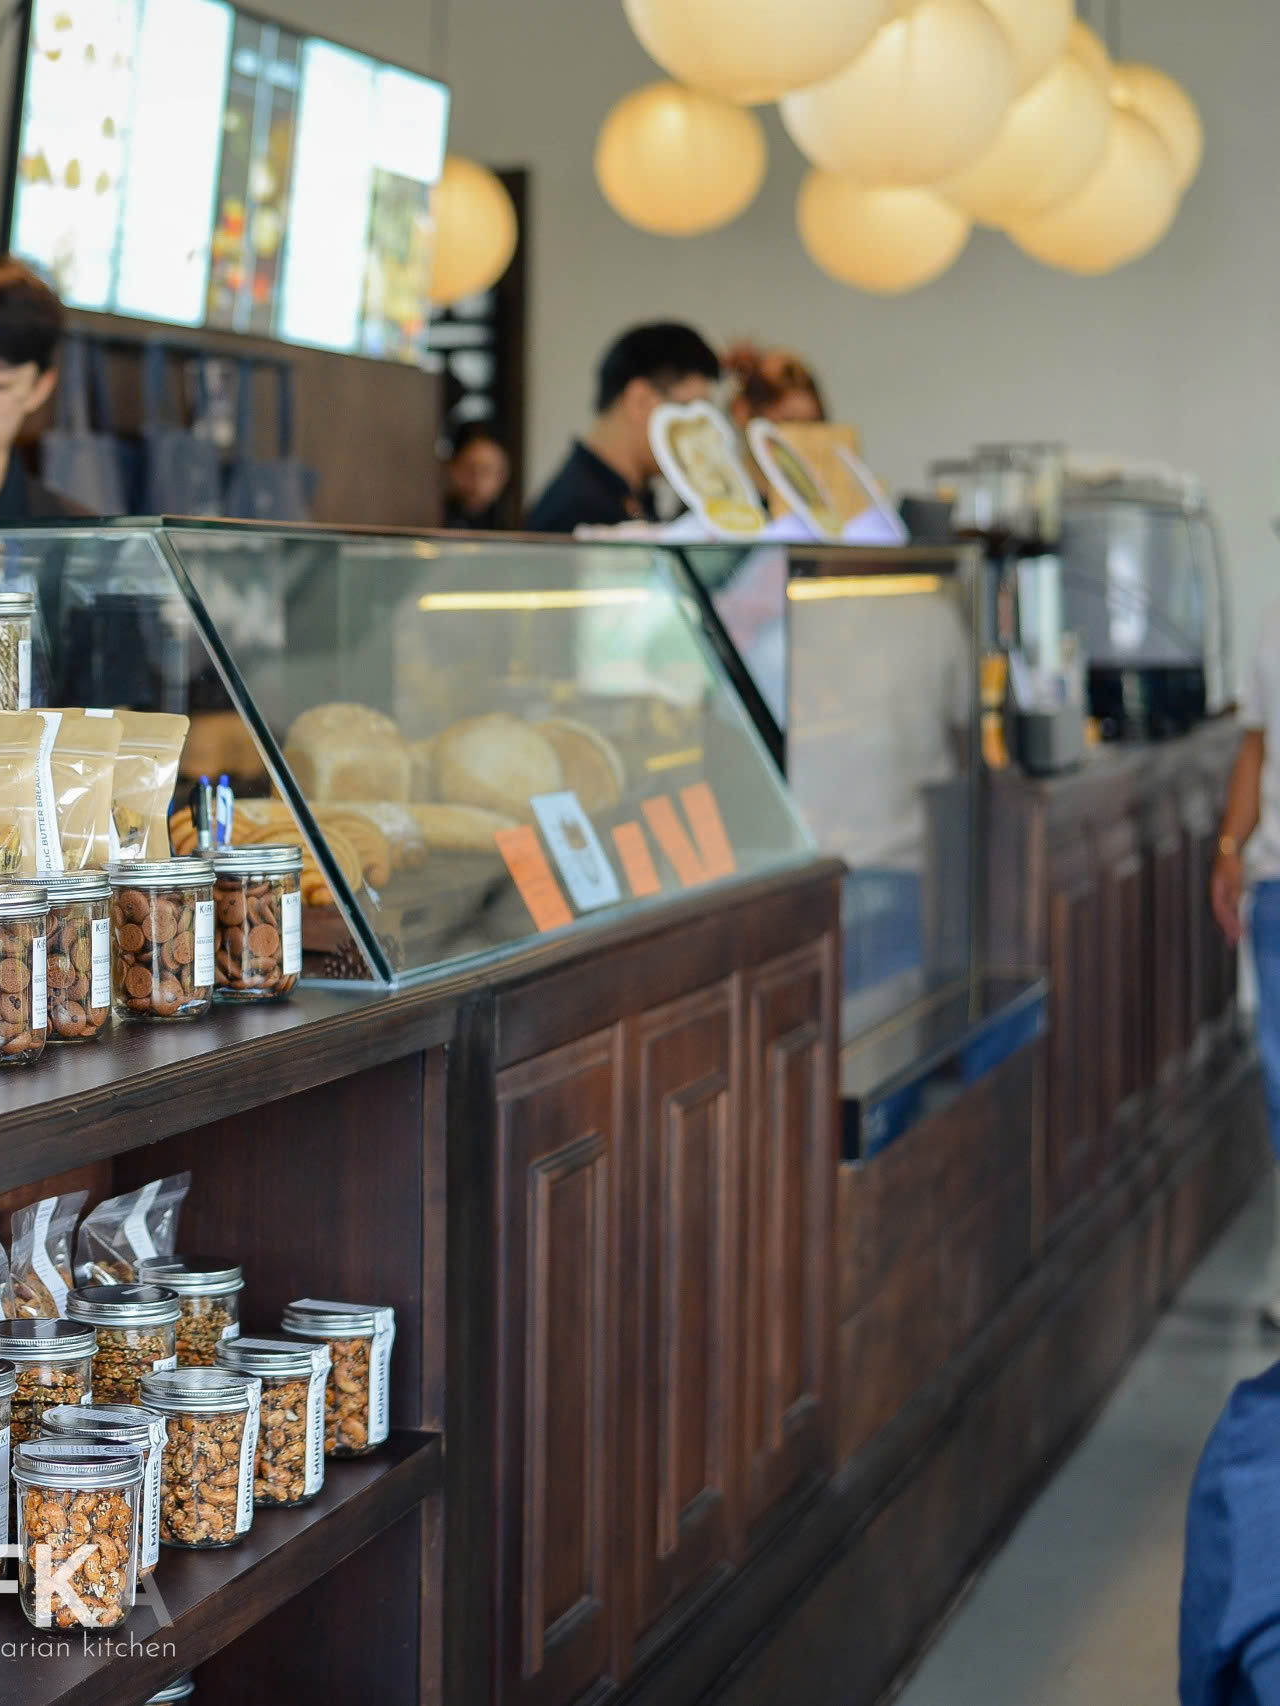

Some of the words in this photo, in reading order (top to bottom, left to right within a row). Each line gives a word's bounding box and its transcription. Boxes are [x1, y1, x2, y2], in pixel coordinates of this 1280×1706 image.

[37, 806, 50, 846] BUTTER
[245, 1430, 254, 1514] MUNCHIES
[313, 1398, 322, 1476] MUNCHIES
[150, 1459, 160, 1548] MUNCHIES
